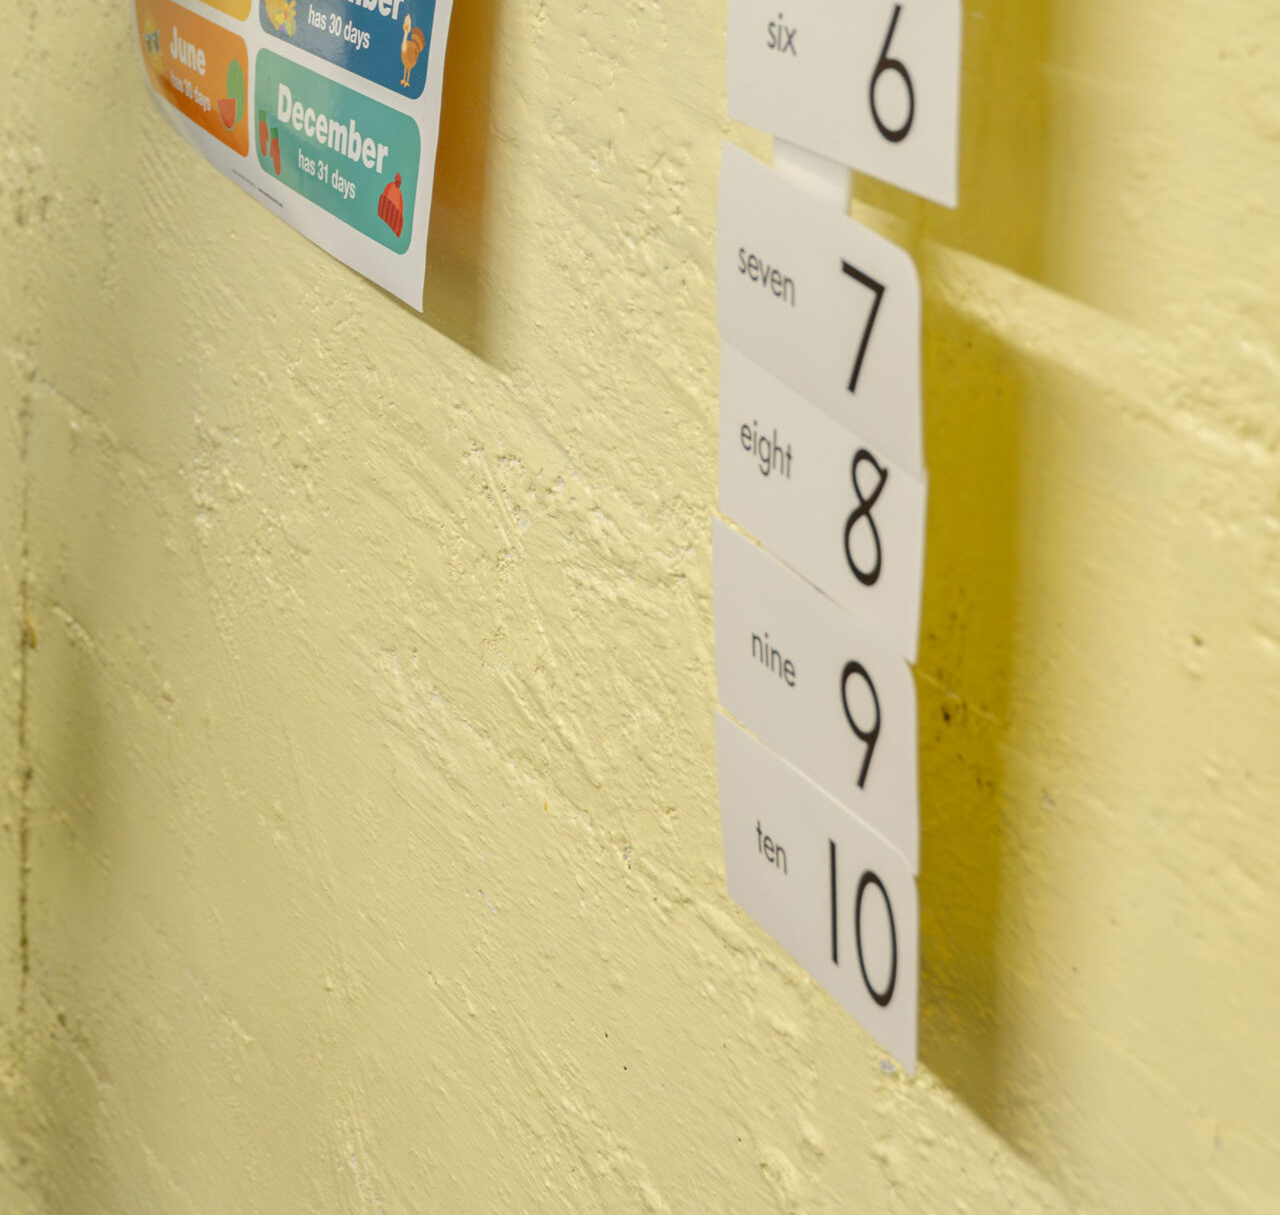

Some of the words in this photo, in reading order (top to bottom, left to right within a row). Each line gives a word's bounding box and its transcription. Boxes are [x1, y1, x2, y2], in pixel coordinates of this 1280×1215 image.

[169, 25, 206, 76] June
[307, 4, 327, 31] has
[328, 13, 343, 37] 30
[344, 20, 371, 51] days
[766, 13, 798, 57] six
[868, 3, 915, 145] 6
[193, 86, 211, 113] days
[277, 83, 389, 175] December
[297, 148, 316, 176] has
[317, 159, 329, 184] 31
[331, 165, 356, 200] days
[738, 246, 796, 308] seven
[841, 258, 887, 395] 7
[740, 419, 794, 480] eight
[843, 448, 888, 587] 8
[751, 631, 797, 689] nine
[840, 660, 881, 790] 9
[756, 819, 788, 875] ten
[828, 838, 898, 1007] 10
